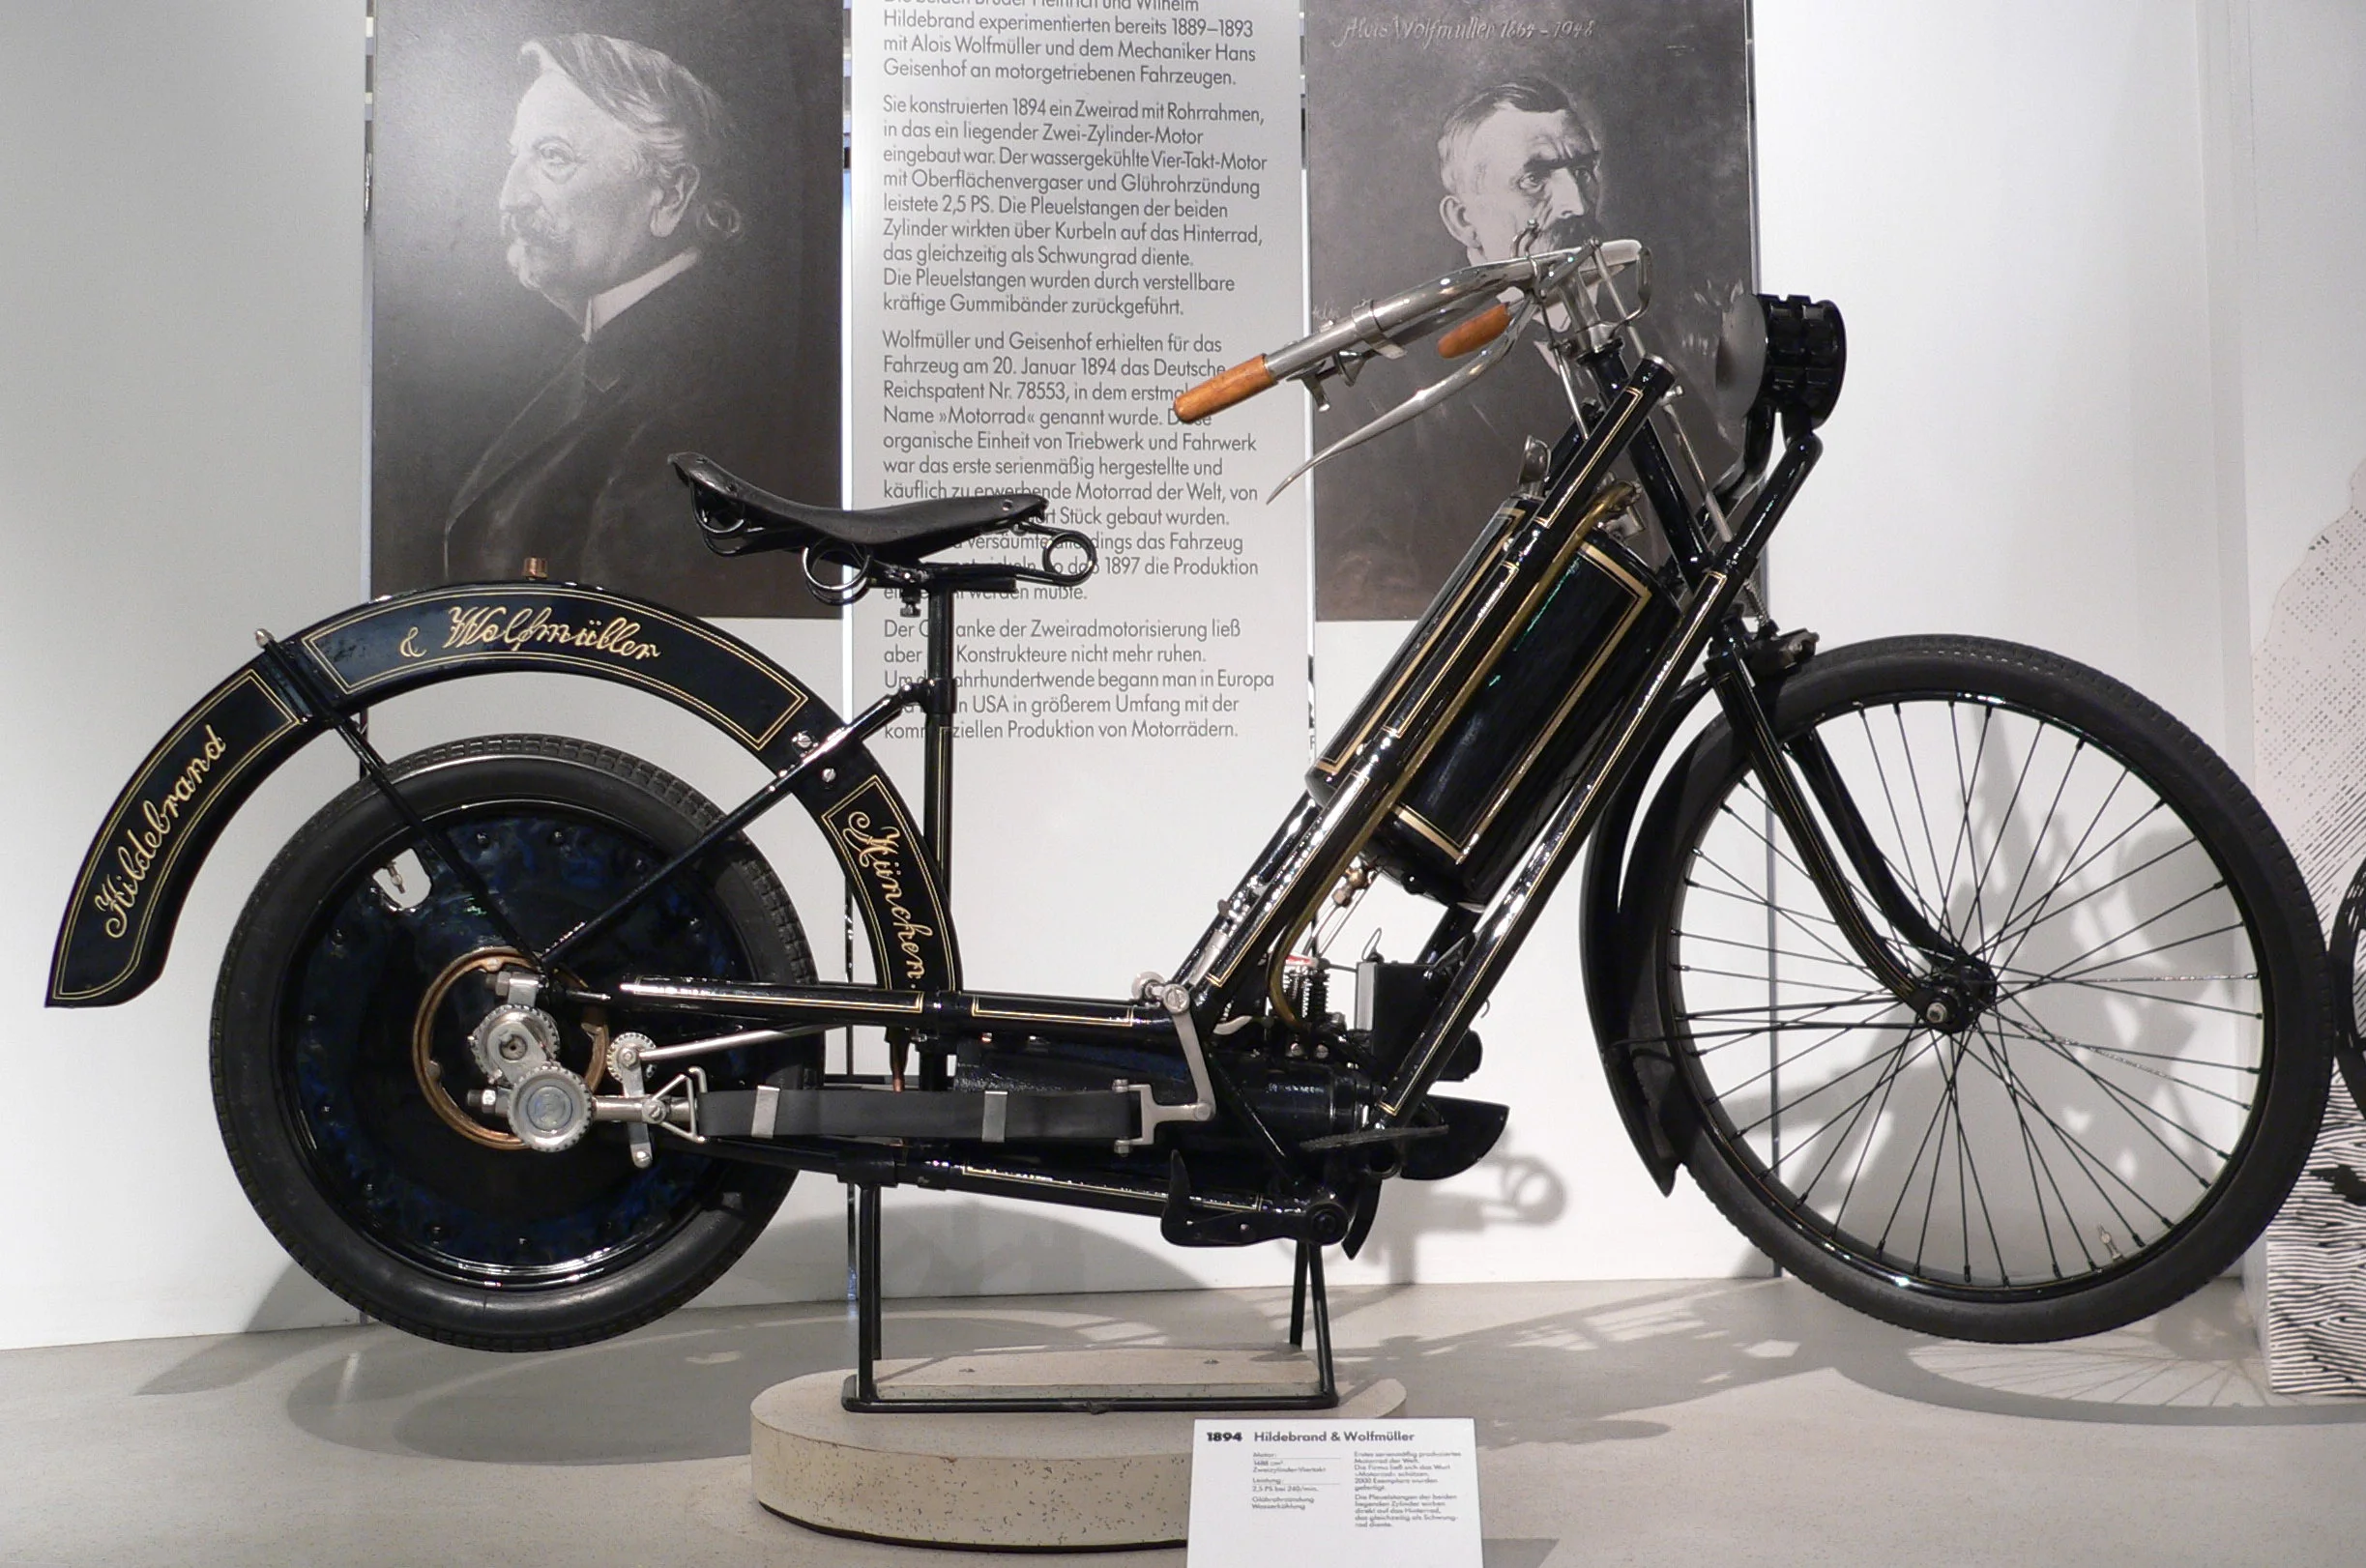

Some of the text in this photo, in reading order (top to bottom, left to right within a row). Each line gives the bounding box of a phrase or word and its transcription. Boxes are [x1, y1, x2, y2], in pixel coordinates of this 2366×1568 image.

[885, 12, 975, 29] Hildebrand
[979, 15, 1110, 36] experimentierten
[1115, 16, 1167, 35] bereits
[885, 38, 1255, 62] mit Alois Wolfmüller und dem Mechaniker Hans
[884, 60, 1236, 89] Geisenhof an motorgetriebenen Fahrzeugen.
[883, 96, 1264, 126] Sie konstruierten 1894 ein Zweirad mit Rohrrahmen,
[884, 126, 897, 136] in
[902, 122, 931, 137] das
[935, 123, 958, 138] ein
[964, 123, 1039, 144] liegender
[884, 145, 961, 166] eingebaut
[964, 152, 996, 164] war.
[999, 149, 1028, 165] Der
[1031, 150, 1149, 171] wassergekühlte
[884, 170, 1260, 199] mit Oberflächenvergaser und Glührohrzündung
[884, 195, 1227, 220] leistete 2,5 PS. Die Pleuelstangen der beiden
[883, 219, 1262, 247] Zylinder wirkten über Kurbeln auf das Hinterrad,
[883, 245, 1193, 270] das gleichzeitig als Schwungrad diente.
[884, 270, 1235, 292] Die Pleuelstangen wurden durch verstellbare
[884, 295, 1183, 319] kräftige Gummibänder zurückgeführt.
[883, 332, 1221, 352] Wolfmüller und Geisenhof erhielten für das
[884, 357, 1226, 379] Fahrzeug am 20. Januar 1894 das Deutsche
[884, 381, 1188, 403] Reichspatent Nr. 78553, in dem erstmal
[884, 407, 934, 423] Name
[1039, 410, 1104, 429] genannt
[1108, 409, 1163, 425] wurde.
[1168, 408, 1212, 425] Dse
[883, 432, 1256, 453] organische Einheit von Triebwerk und Fahrwerk
[883, 457, 1222, 479] war das erste serienmäßig hergestellte und
[884, 479, 948, 500] käuflich
[1075, 482, 1152, 500] Motorrad
[1156, 483, 1183, 500] der
[1186, 483, 1226, 504] Welt,
[1230, 488, 1257, 501] von
[1060, 508, 1102, 524] Stück
[1106, 508, 1162, 530] gebaut
[1166, 508, 1229, 525] wurden.
[1137, 533, 1165, 550] das
[1170, 534, 1242, 555] Fahrzeug
[1105, 557, 1140, 574] 1897
[1145, 558, 1169, 574] die
[1174, 558, 1258, 575] Produktion
[399, 606, 662, 660] & Wolfmüller
[884, 620, 1241, 642] Der anke der Zweiradmotorisierung ließ
[884, 644, 1206, 663] aber Konstrukteure nicht mehr ruhen.
[956, 671, 1095, 688] ahrhundertwende
[1098, 670, 1158, 692] begann
[1163, 675, 1196, 687] man
[1201, 670, 1213, 686] in
[1218, 670, 1273, 691] Europa
[973, 695, 1009, 713] USA
[1013, 695, 1027, 712] in
[1032, 695, 1110, 717] größerem
[1116, 695, 1180, 716] Umfang
[1185, 695, 1209, 711] mit
[1212, 695, 1240, 711] der
[884, 719, 1238, 739] komziellen Produktion von Motorrädern.
[95, 724, 226, 939] Hildebrand
[1207, 1431, 1416, 1441] 1894 Hildebrand & Wolfmüller
